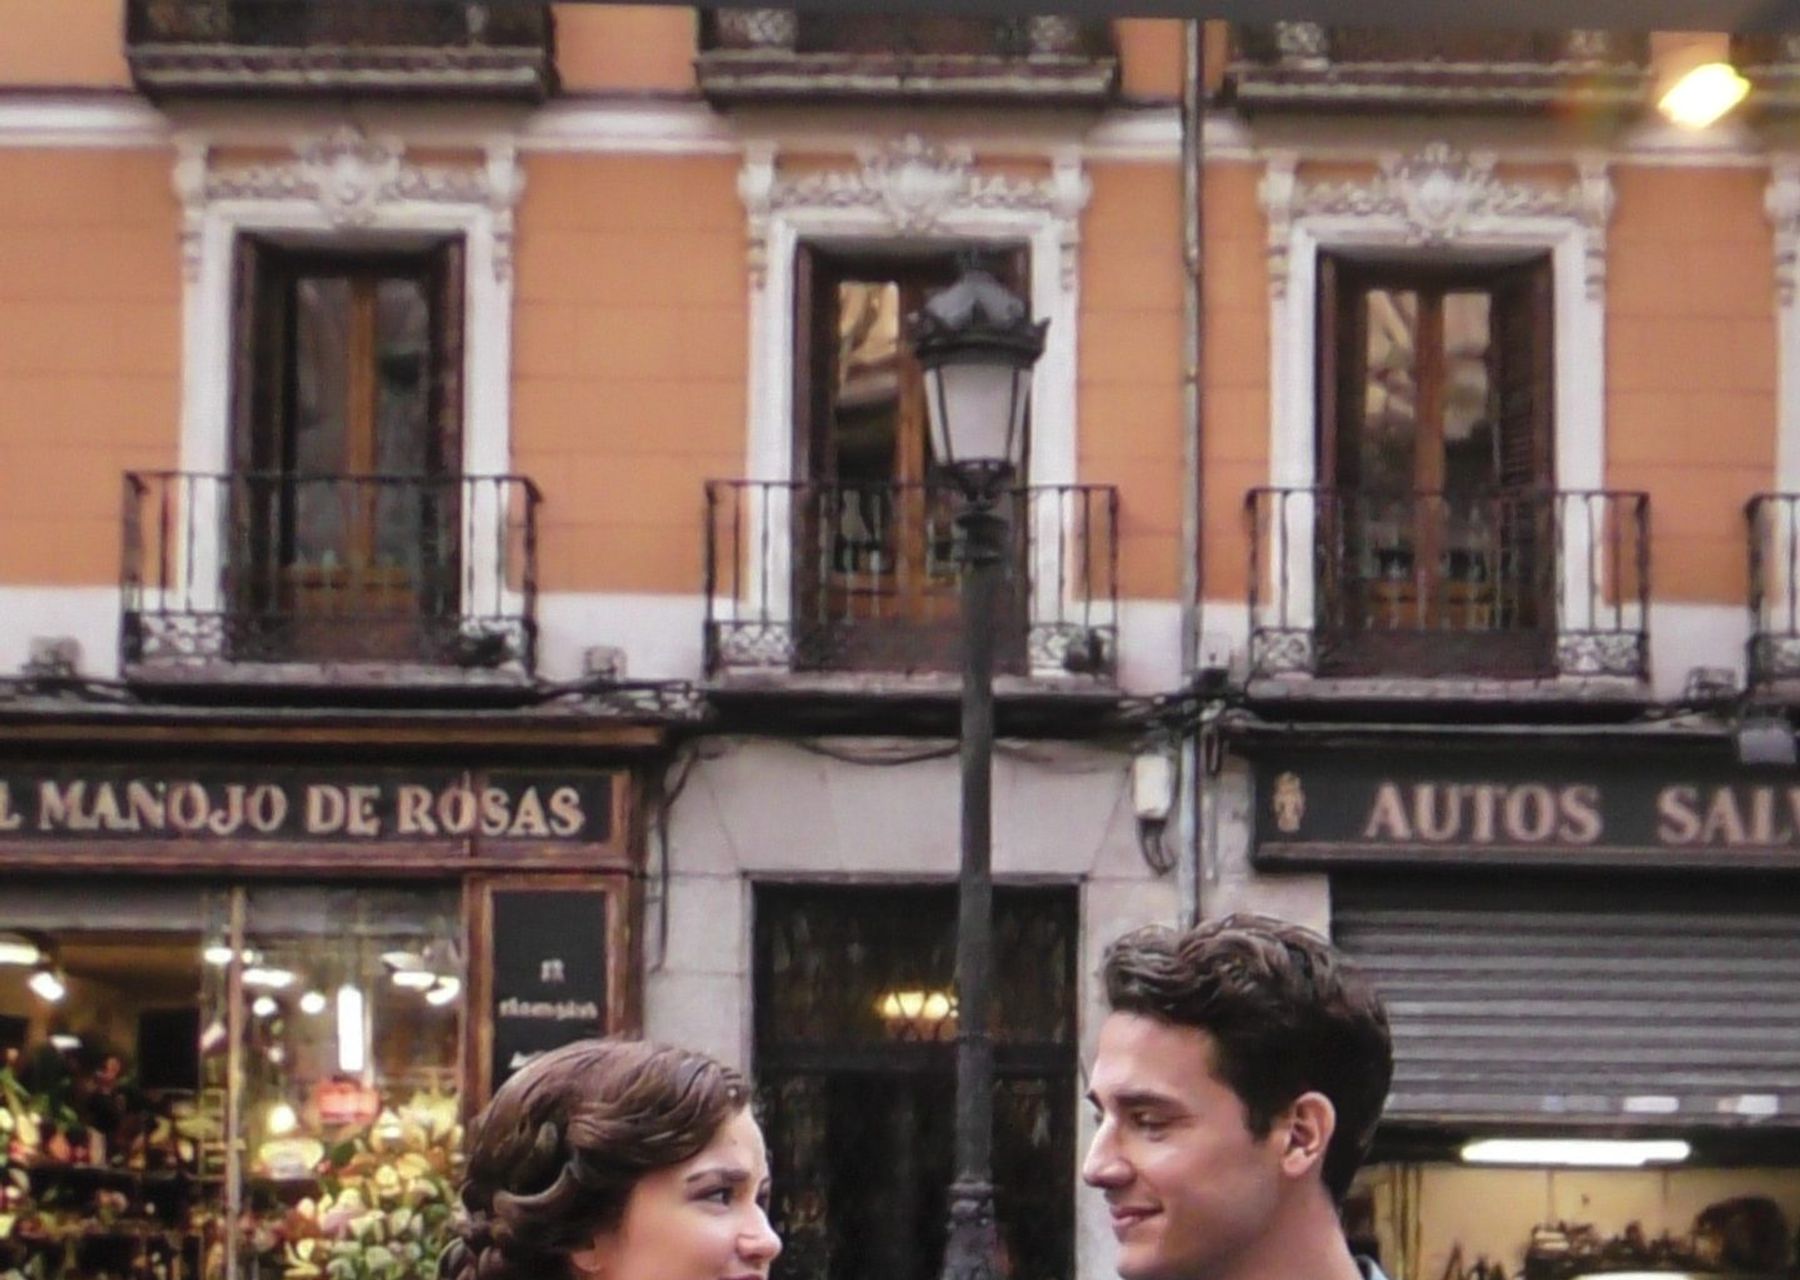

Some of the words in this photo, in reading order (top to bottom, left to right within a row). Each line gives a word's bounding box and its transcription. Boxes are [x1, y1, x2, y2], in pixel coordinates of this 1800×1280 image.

[38, 780, 288, 835] MANOJO
[306, 785, 381, 835] DE
[398, 785, 586, 835] ROSAS
[1364, 782, 1604, 842] AUTOS
